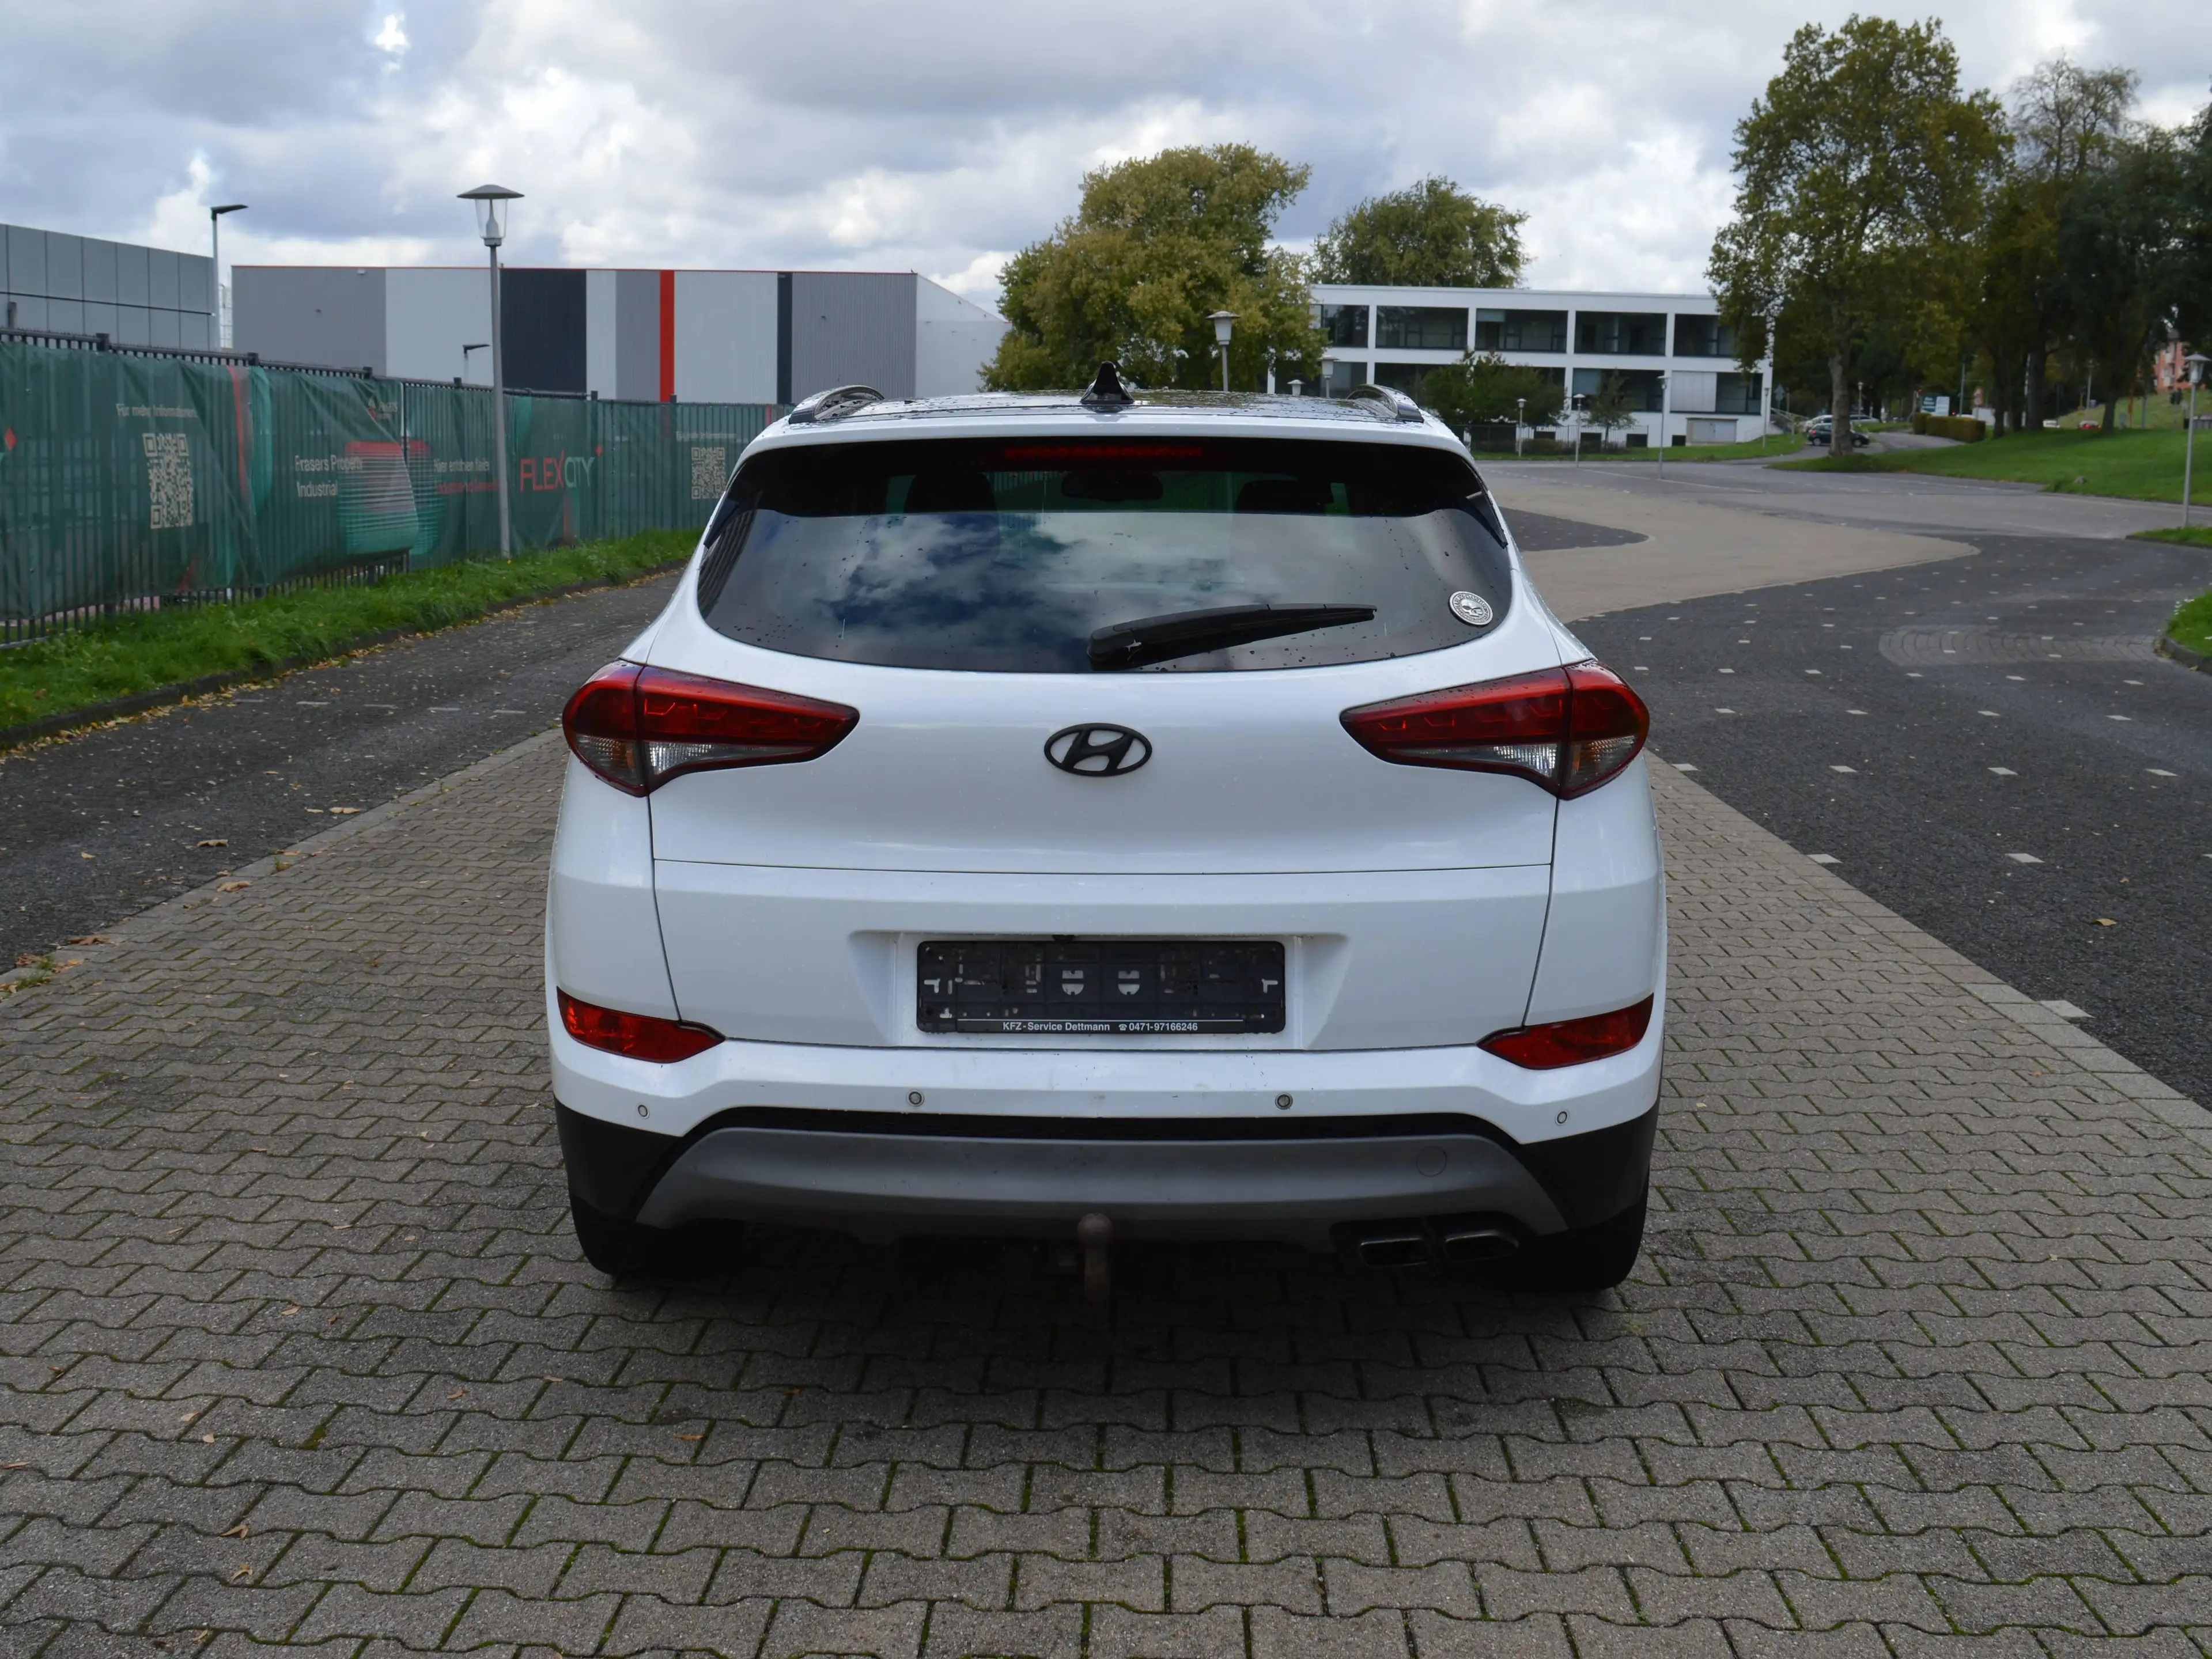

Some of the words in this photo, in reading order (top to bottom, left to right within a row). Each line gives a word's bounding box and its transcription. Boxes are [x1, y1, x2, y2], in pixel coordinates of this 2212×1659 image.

[294, 455, 329, 472] Frasers
[297, 480, 338, 498] Industrial
[1065, 1022, 1110, 1031] Dettmann
[1129, 1022, 1198, 1031] 0471-97166246
